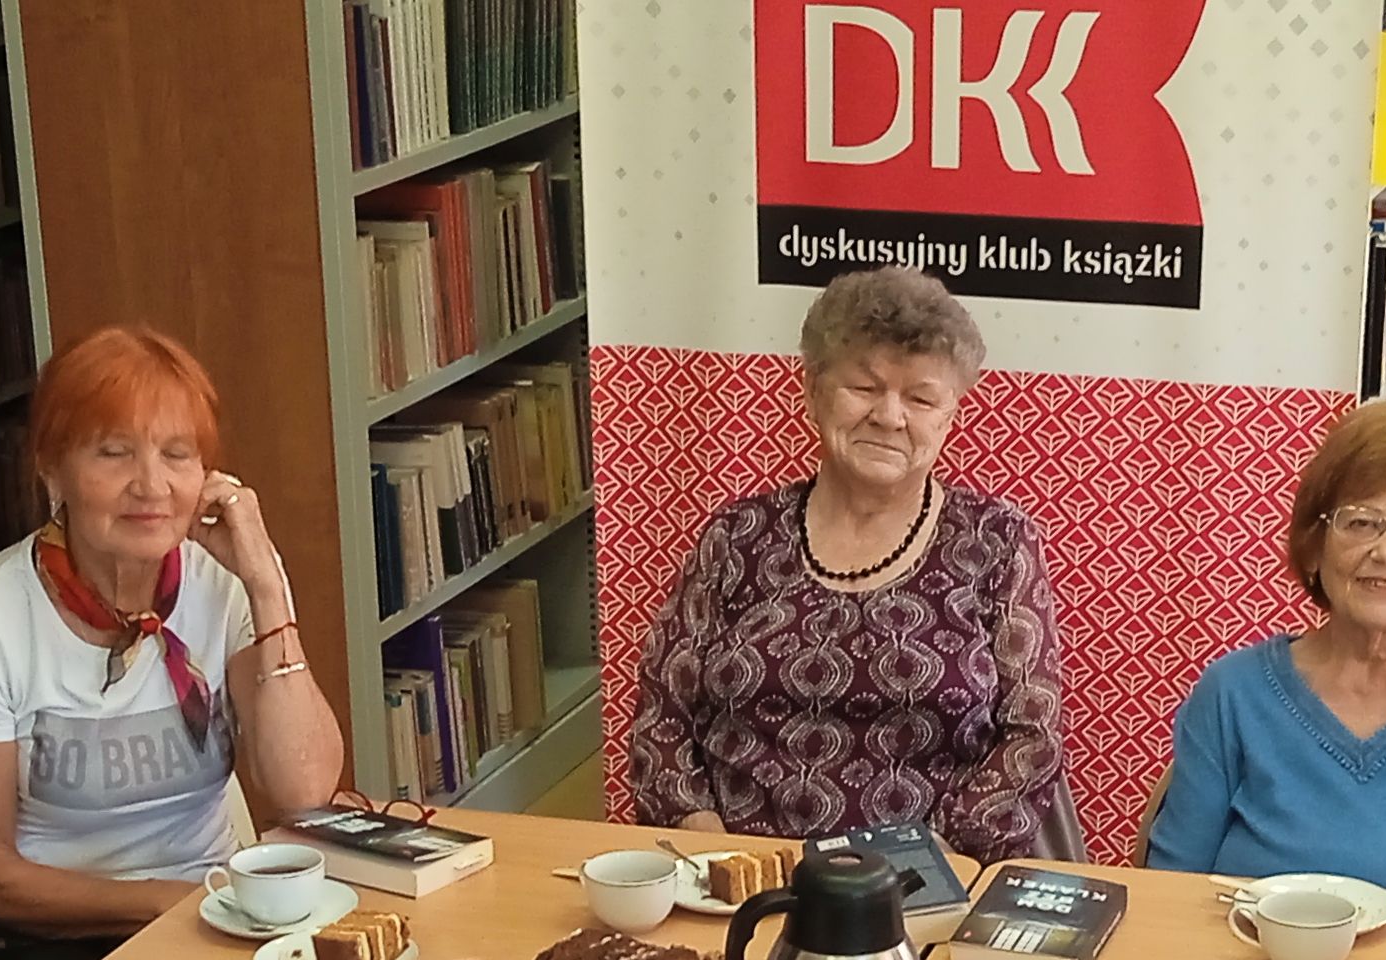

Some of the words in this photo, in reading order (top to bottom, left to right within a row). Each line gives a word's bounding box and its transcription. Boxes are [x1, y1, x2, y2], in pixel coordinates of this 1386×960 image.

[778, 225, 967, 276] dyskusyjny
[978, 236, 1051, 273] klub
[1064, 240, 1183, 284] książki
